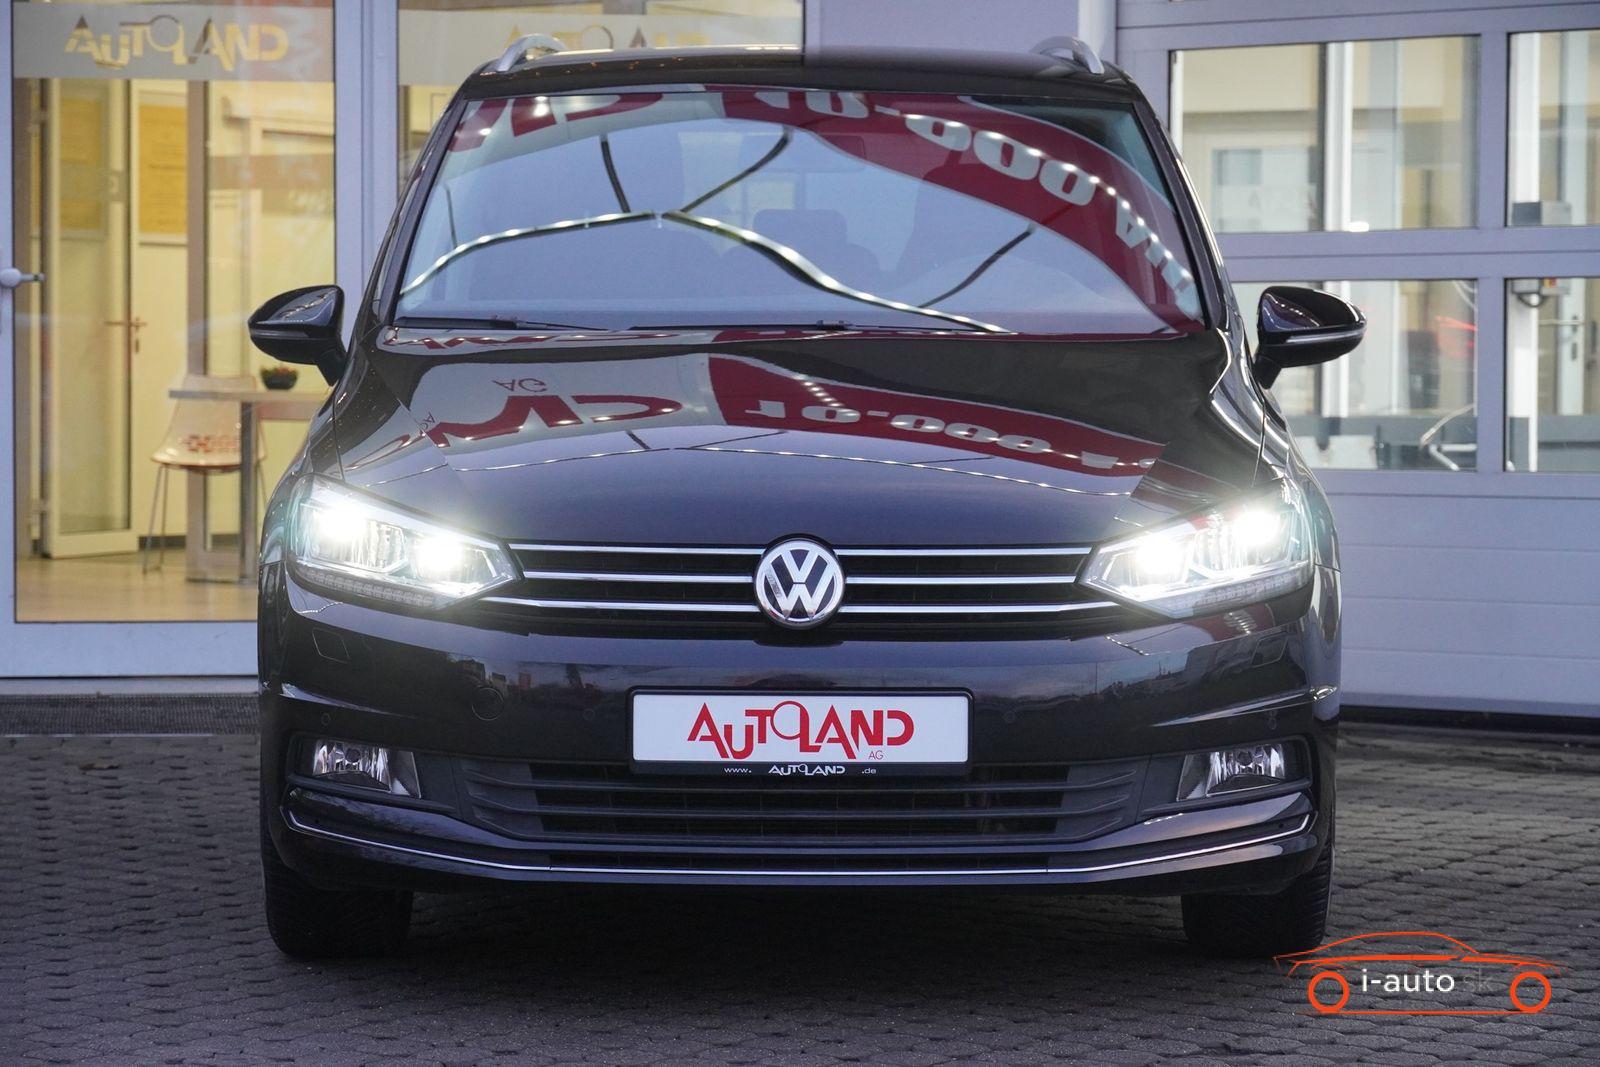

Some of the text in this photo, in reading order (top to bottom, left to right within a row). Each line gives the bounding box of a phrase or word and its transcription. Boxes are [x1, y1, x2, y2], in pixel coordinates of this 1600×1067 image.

[64, 15, 289, 71] AUTOLAND
[687, 700, 914, 759] AUTOLAND
[768, 764, 846, 776] AUTOLAND
[868, 750, 884, 760] AG
